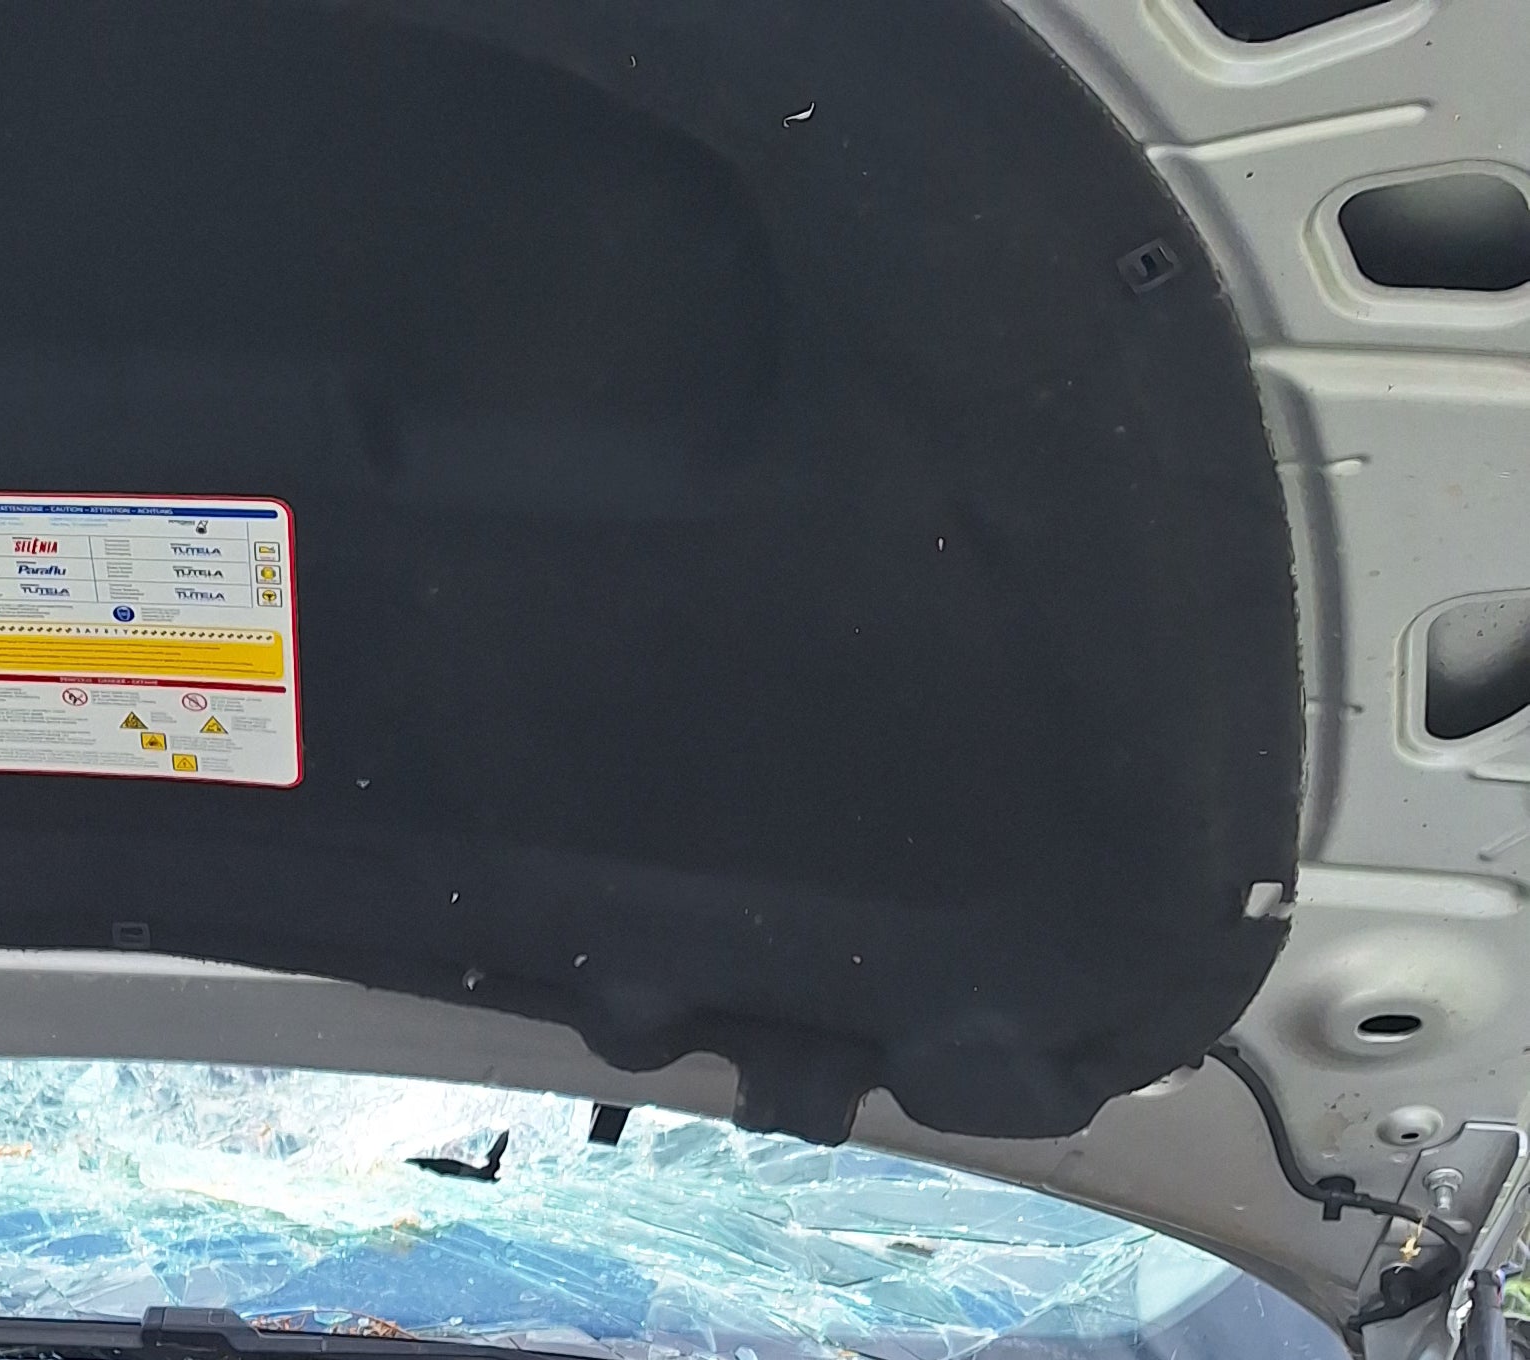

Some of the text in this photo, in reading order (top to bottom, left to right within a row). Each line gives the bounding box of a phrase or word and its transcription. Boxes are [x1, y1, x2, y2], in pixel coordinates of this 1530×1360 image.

[14, 538, 58, 554] SELENIA
[171, 546, 221, 556] TUTELA
[18, 564, 66, 576] Paraflu
[174, 569, 224, 578] TUTELA
[21, 586, 70, 596] TUTELA
[176, 591, 225, 601] TUTELA
